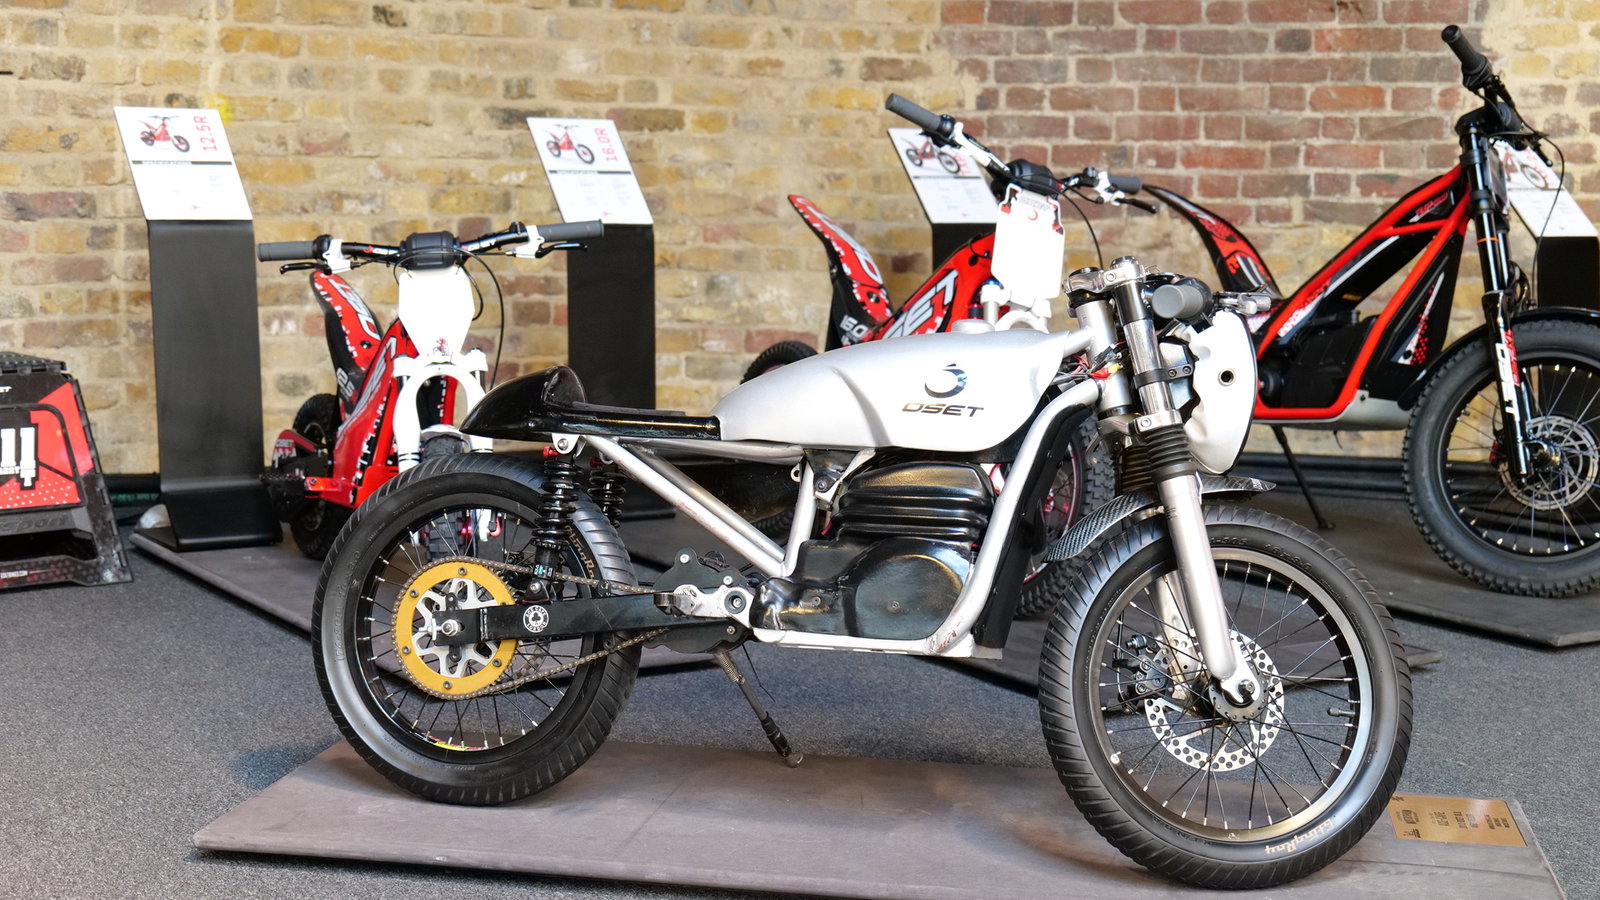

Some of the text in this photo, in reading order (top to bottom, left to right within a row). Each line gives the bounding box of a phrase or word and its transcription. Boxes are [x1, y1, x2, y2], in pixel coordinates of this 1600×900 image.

[193, 115, 218, 152] 12.5R
[594, 128, 618, 162] 16.0R
[901, 402, 984, 417] OSET
